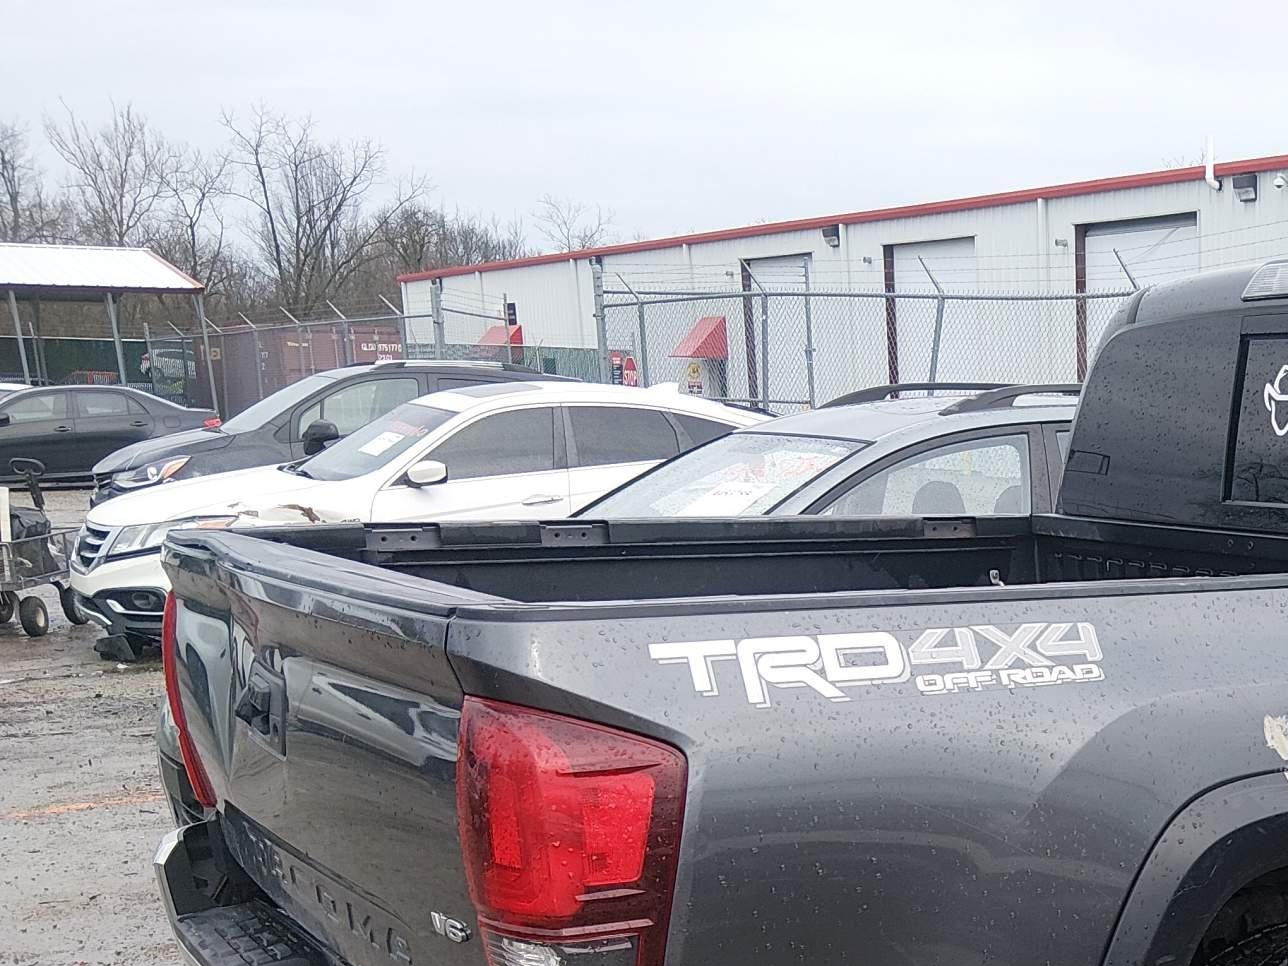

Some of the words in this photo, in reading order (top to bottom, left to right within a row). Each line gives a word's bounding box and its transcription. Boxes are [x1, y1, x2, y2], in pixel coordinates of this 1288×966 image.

[648, 631, 911, 708] TRD
[908, 622, 1103, 669] 4X4
[915, 670, 997, 696] OFF
[999, 663, 1105, 689] ROAD
[430, 911, 473, 943] V6
